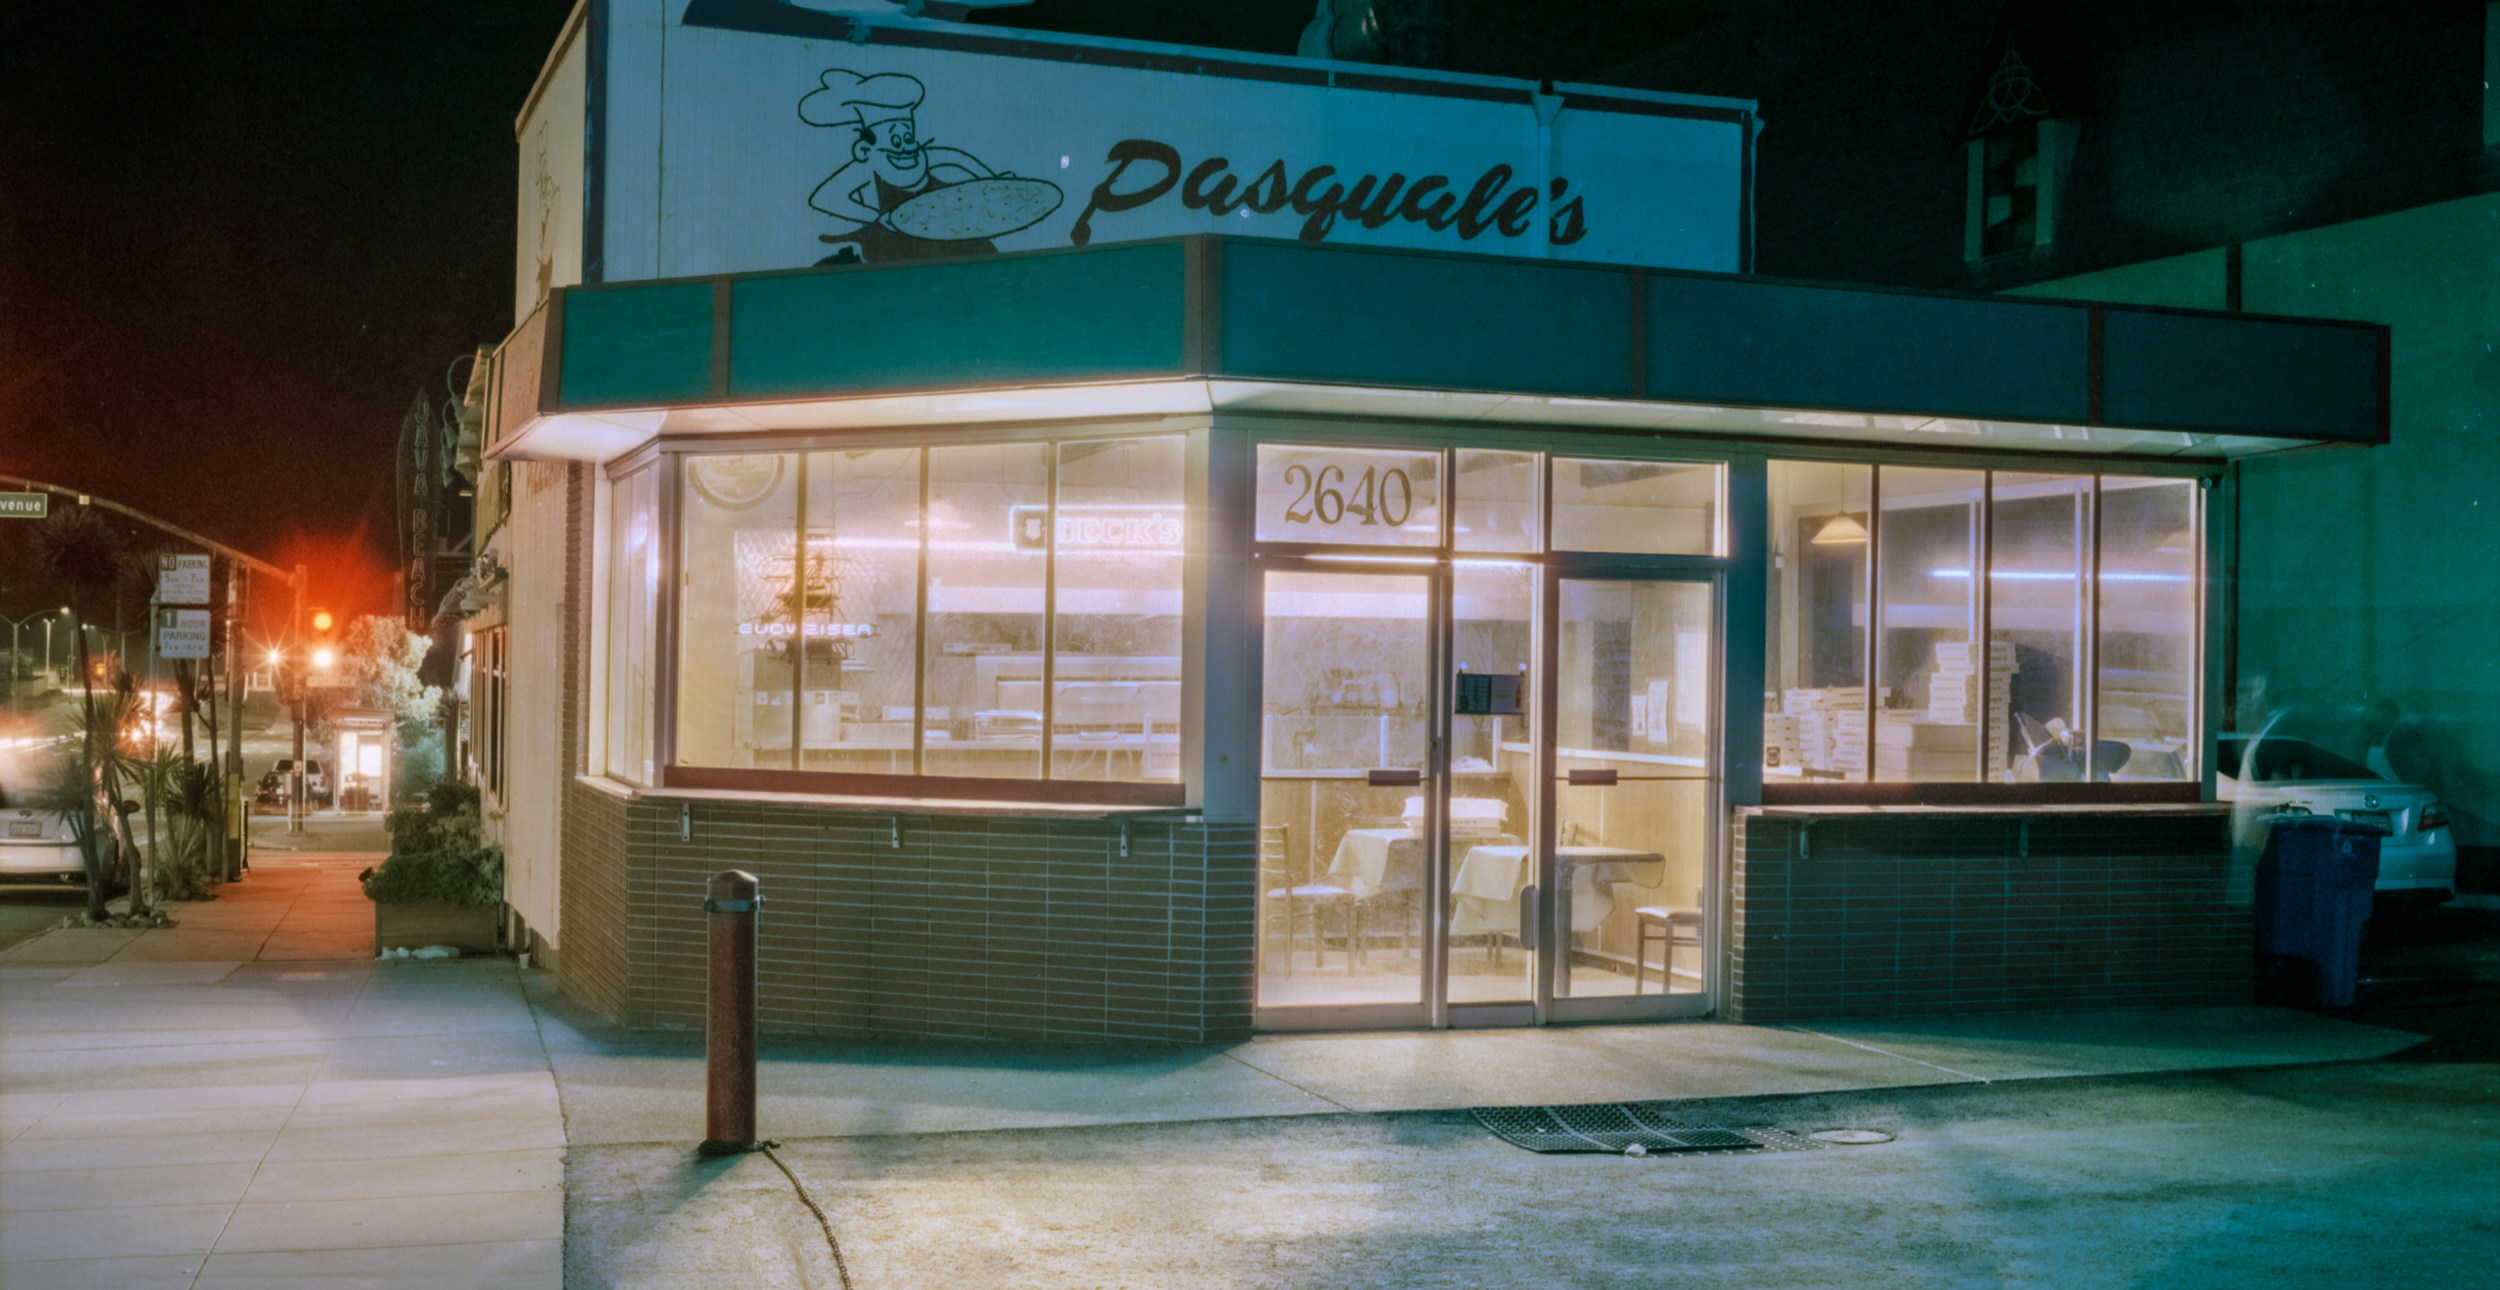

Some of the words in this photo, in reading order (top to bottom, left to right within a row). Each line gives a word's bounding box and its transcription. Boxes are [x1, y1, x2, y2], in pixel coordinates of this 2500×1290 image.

[1070, 138, 1588, 246] Pasquale's
[413, 400, 429, 497] JAVA
[1283, 464, 1412, 527] 2640
[1056, 513, 1183, 545] BECK'S
[161, 556, 175, 569] NO
[177, 559, 208, 570] PARKING
[410, 508, 428, 629] BEACH
[163, 631, 206, 641] PARKING
[166, 611, 172, 627] 1
[180, 619, 206, 629] HOUR
